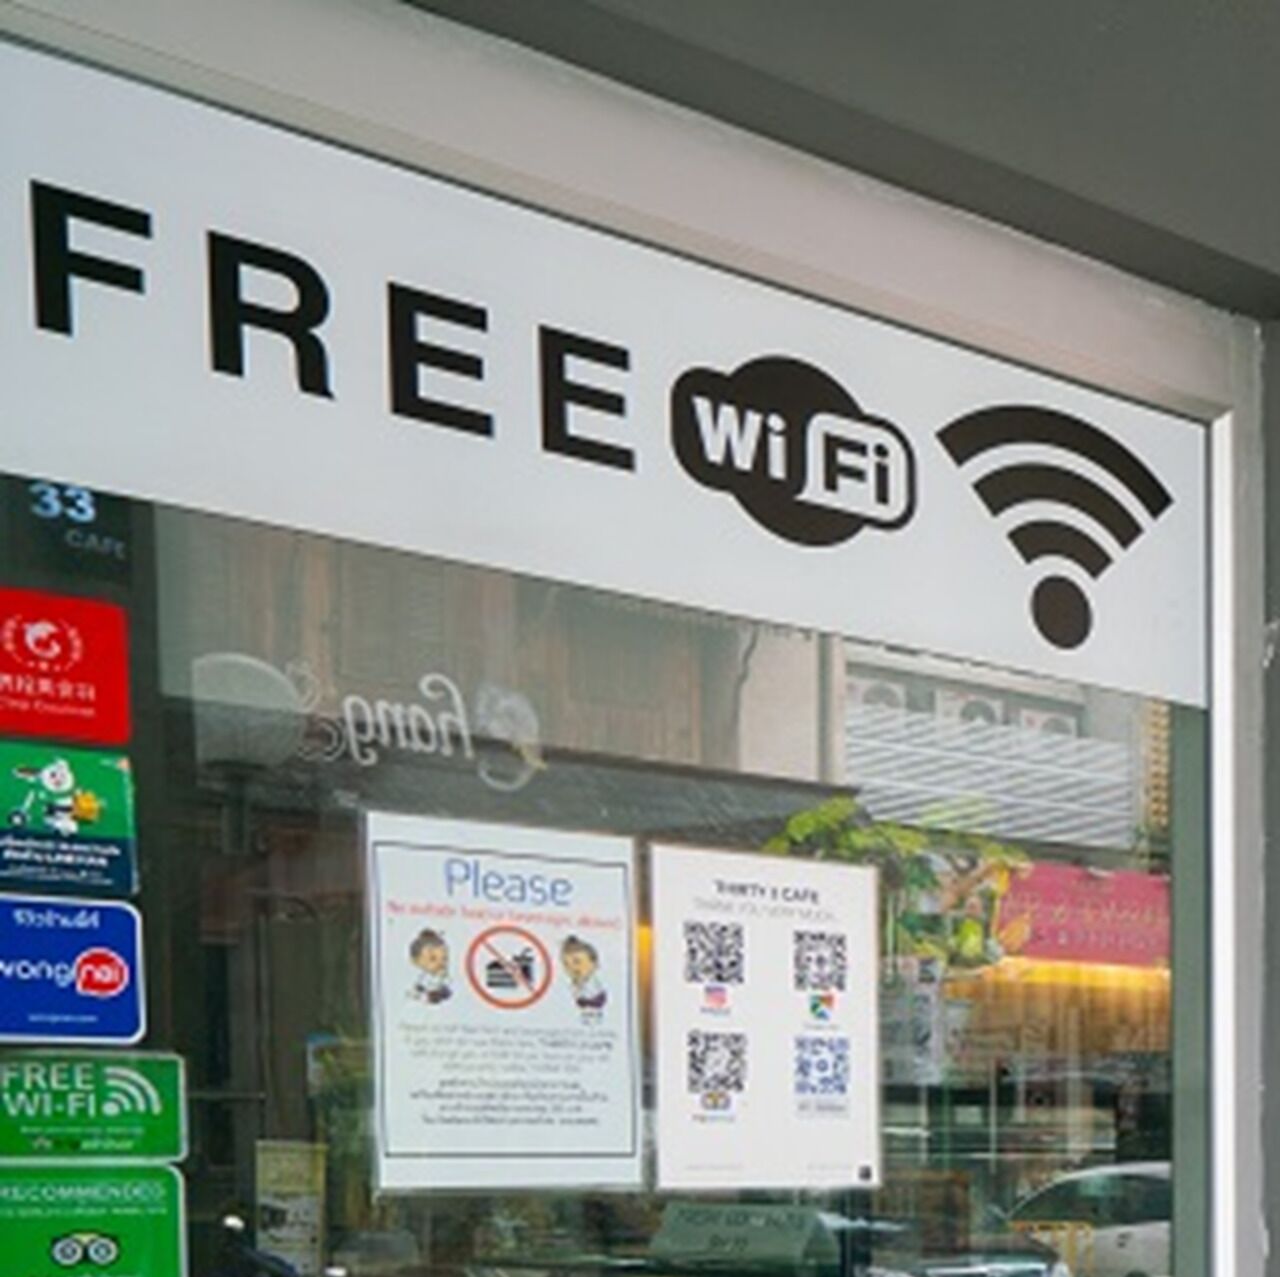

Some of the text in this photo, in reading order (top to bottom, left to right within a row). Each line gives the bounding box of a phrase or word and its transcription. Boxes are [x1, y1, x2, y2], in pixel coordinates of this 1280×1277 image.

[30, 180, 637, 473] FREE
[29, 482, 97, 523] 33
[444, 857, 573, 906] Please
[2, 1063, 96, 1090] FREE
